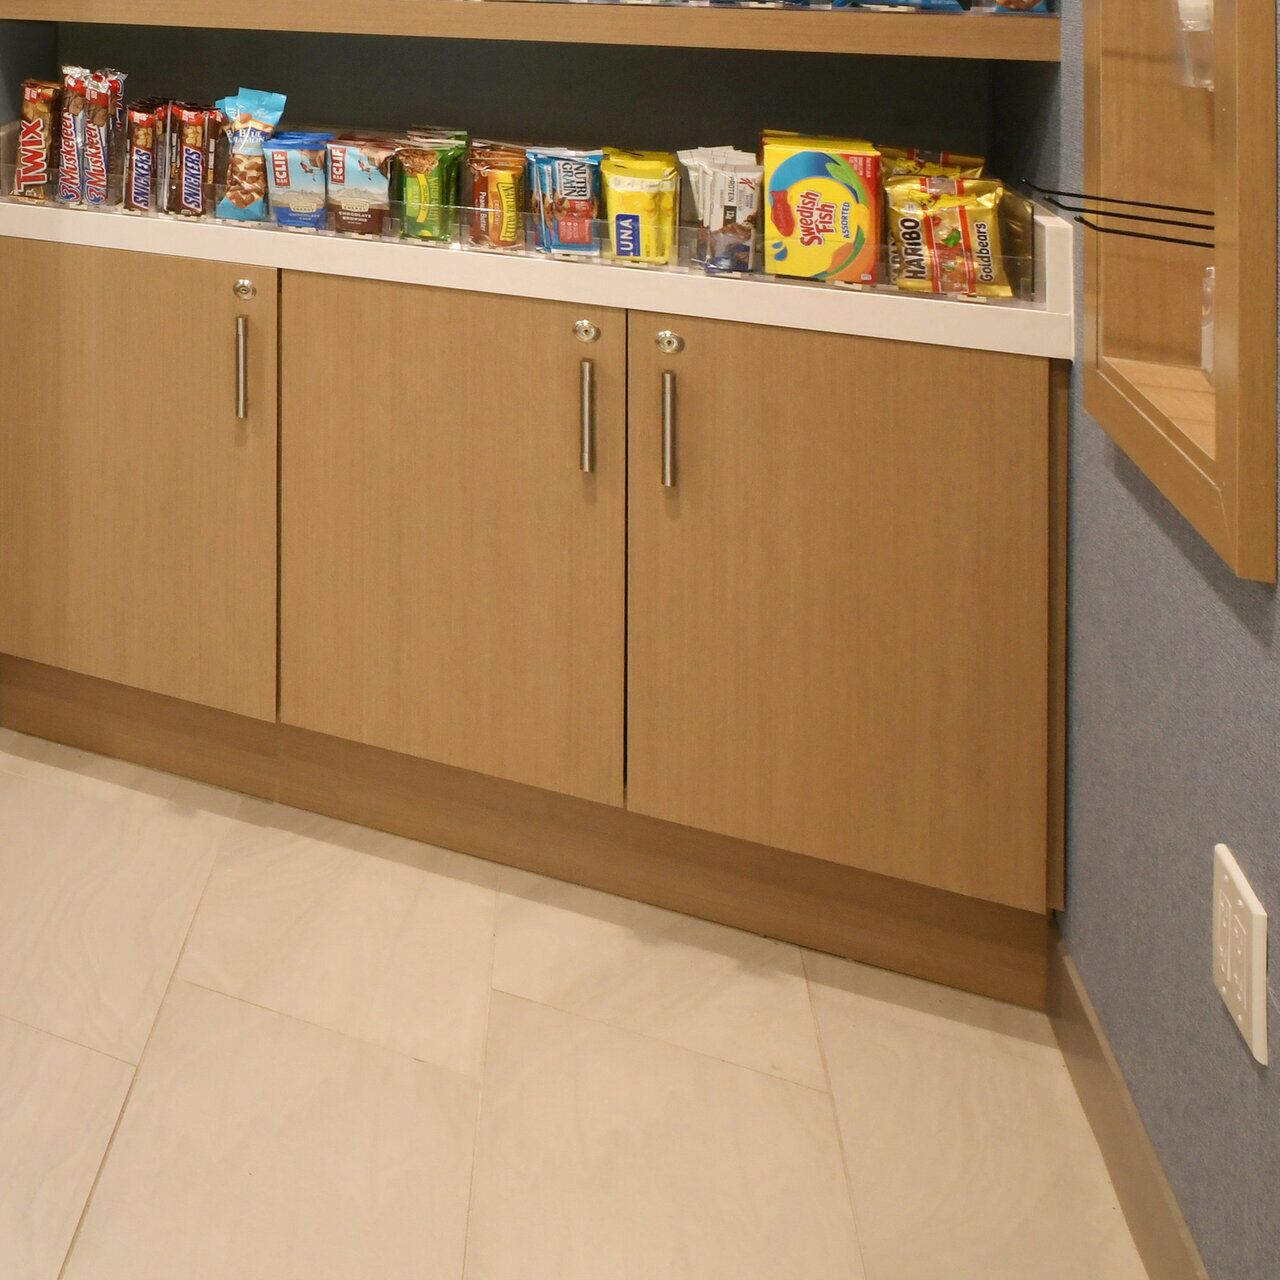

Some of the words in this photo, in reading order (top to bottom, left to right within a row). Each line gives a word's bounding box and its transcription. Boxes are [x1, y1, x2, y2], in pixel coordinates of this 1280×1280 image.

[16, 119, 47, 191] TWIX
[134, 148, 151, 207] SNICKERS
[184, 148, 202, 211] SNICKERS
[561, 162, 576, 197] GRAIN
[573, 163, 588, 197] NUTRI
[800, 190, 821, 247] Swedish
[817, 202, 835, 239] Fish
[902, 218, 922, 279] HARIBO
[977, 223, 993, 282] Goldbears
